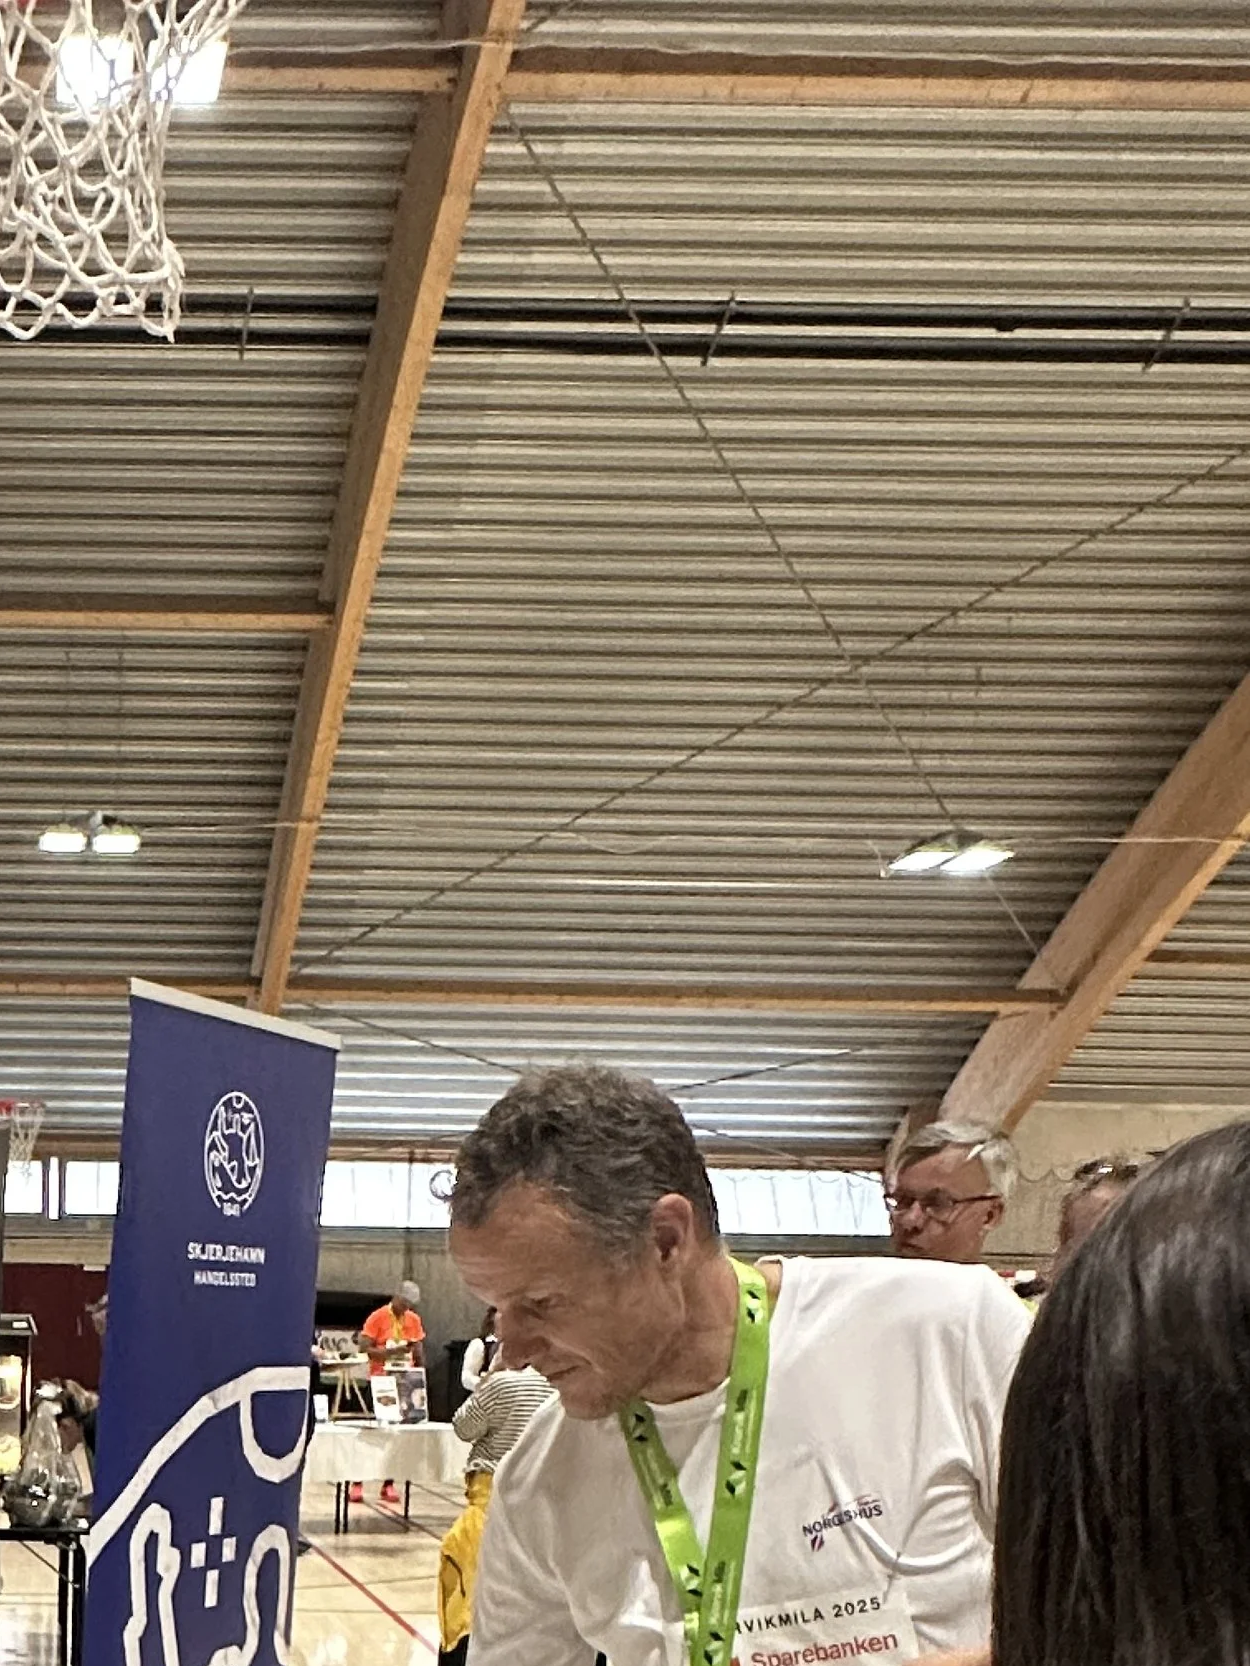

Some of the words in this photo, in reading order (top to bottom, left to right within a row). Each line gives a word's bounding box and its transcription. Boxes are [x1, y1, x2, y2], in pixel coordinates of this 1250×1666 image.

[187, 1242, 265, 1264] SKJERJEHAMN
[193, 1270, 256, 1287] HANDELSSTED
[832, 1596, 881, 1619] 2025
